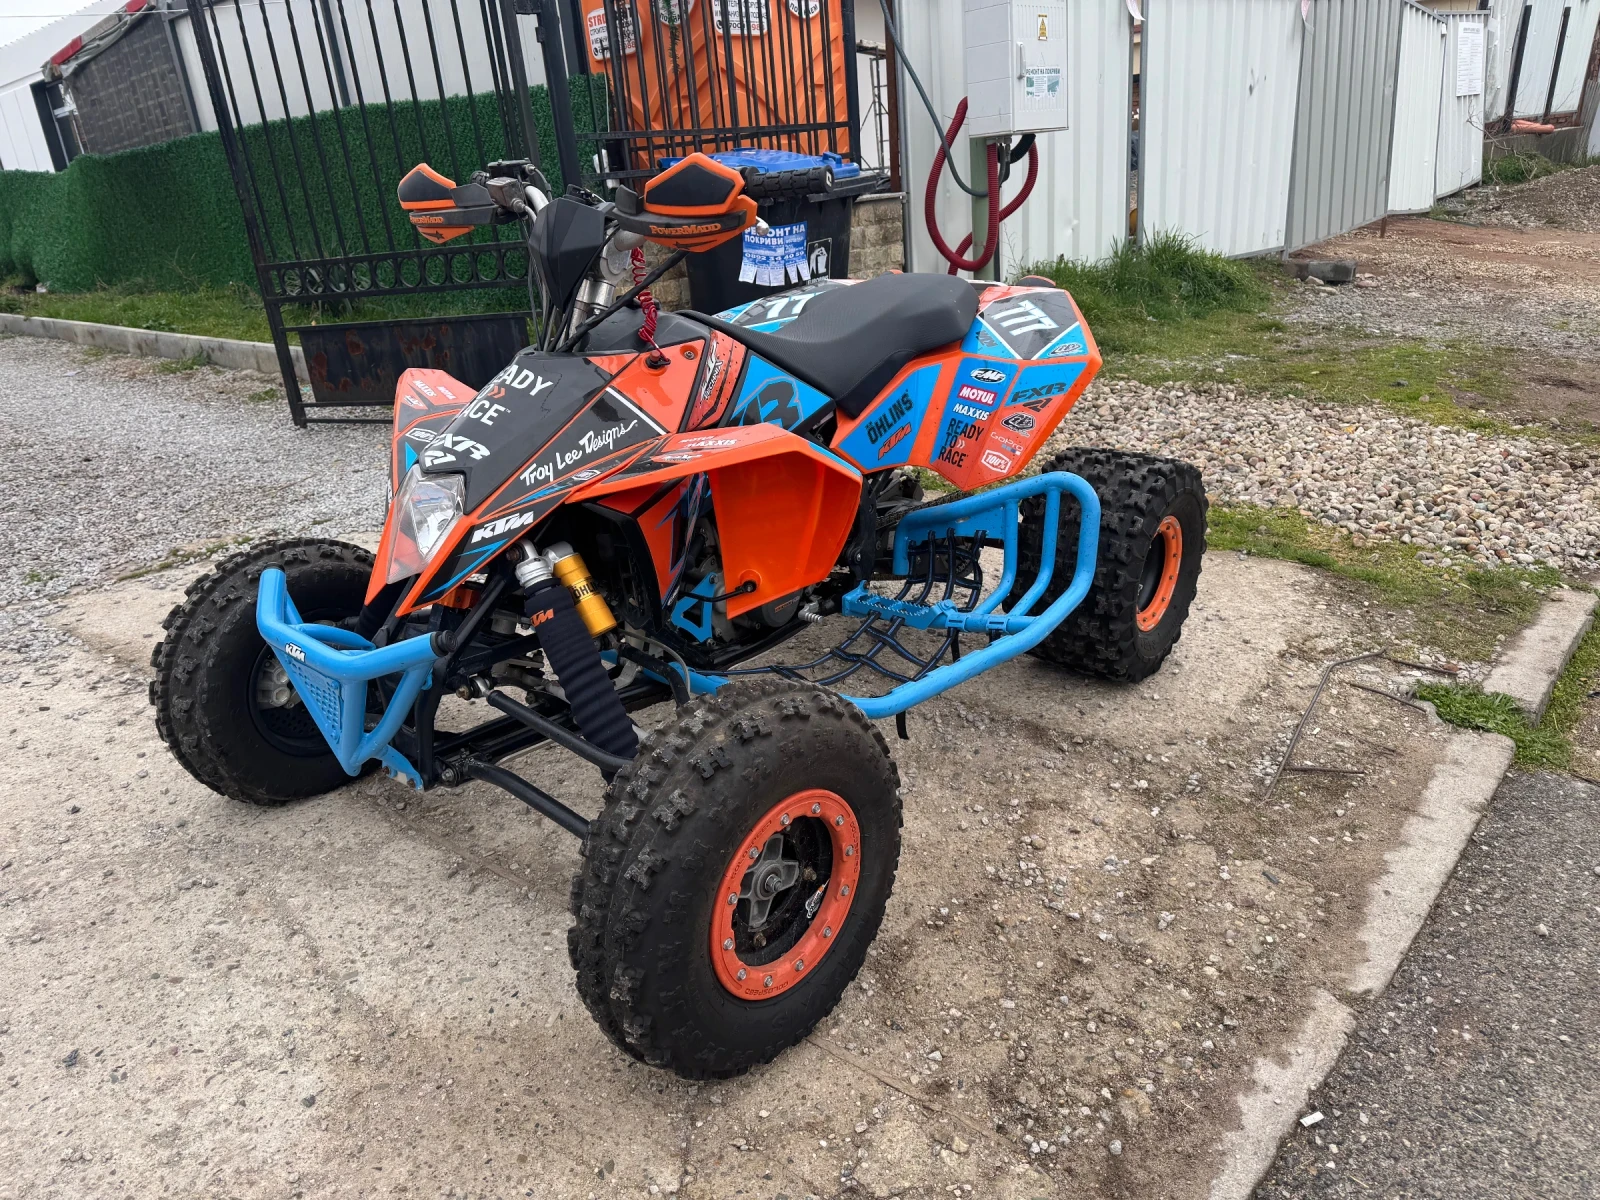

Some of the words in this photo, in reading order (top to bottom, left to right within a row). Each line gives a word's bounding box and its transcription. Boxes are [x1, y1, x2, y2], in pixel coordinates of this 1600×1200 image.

[744, 234, 784, 246] ПОКРИВИ
[745, 226, 790, 238] РЕОНТ
[793, 224, 805, 233] НА
[991, 300, 1059, 336] 777
[971, 369, 1006, 382] FMF
[960, 386, 995, 405] MOTUL
[1011, 382, 1067, 403] FXR
[865, 391, 913, 444] ÖHLINS
[953, 403, 990, 421] MAXXIS
[947, 417, 985, 442] READY
[878, 422, 912, 460] KTM
[945, 431, 959, 449] TO
[520, 463, 554, 486] Troy
[556, 450, 582, 470] Lee
[579, 420, 638, 454] Designs
[938, 445, 967, 468] RACE
[986, 454, 1008, 470] 100%
[471, 511, 534, 544] KTM
[573, 582, 597, 600] ÖHLI
[285, 642, 306, 662] KTM
